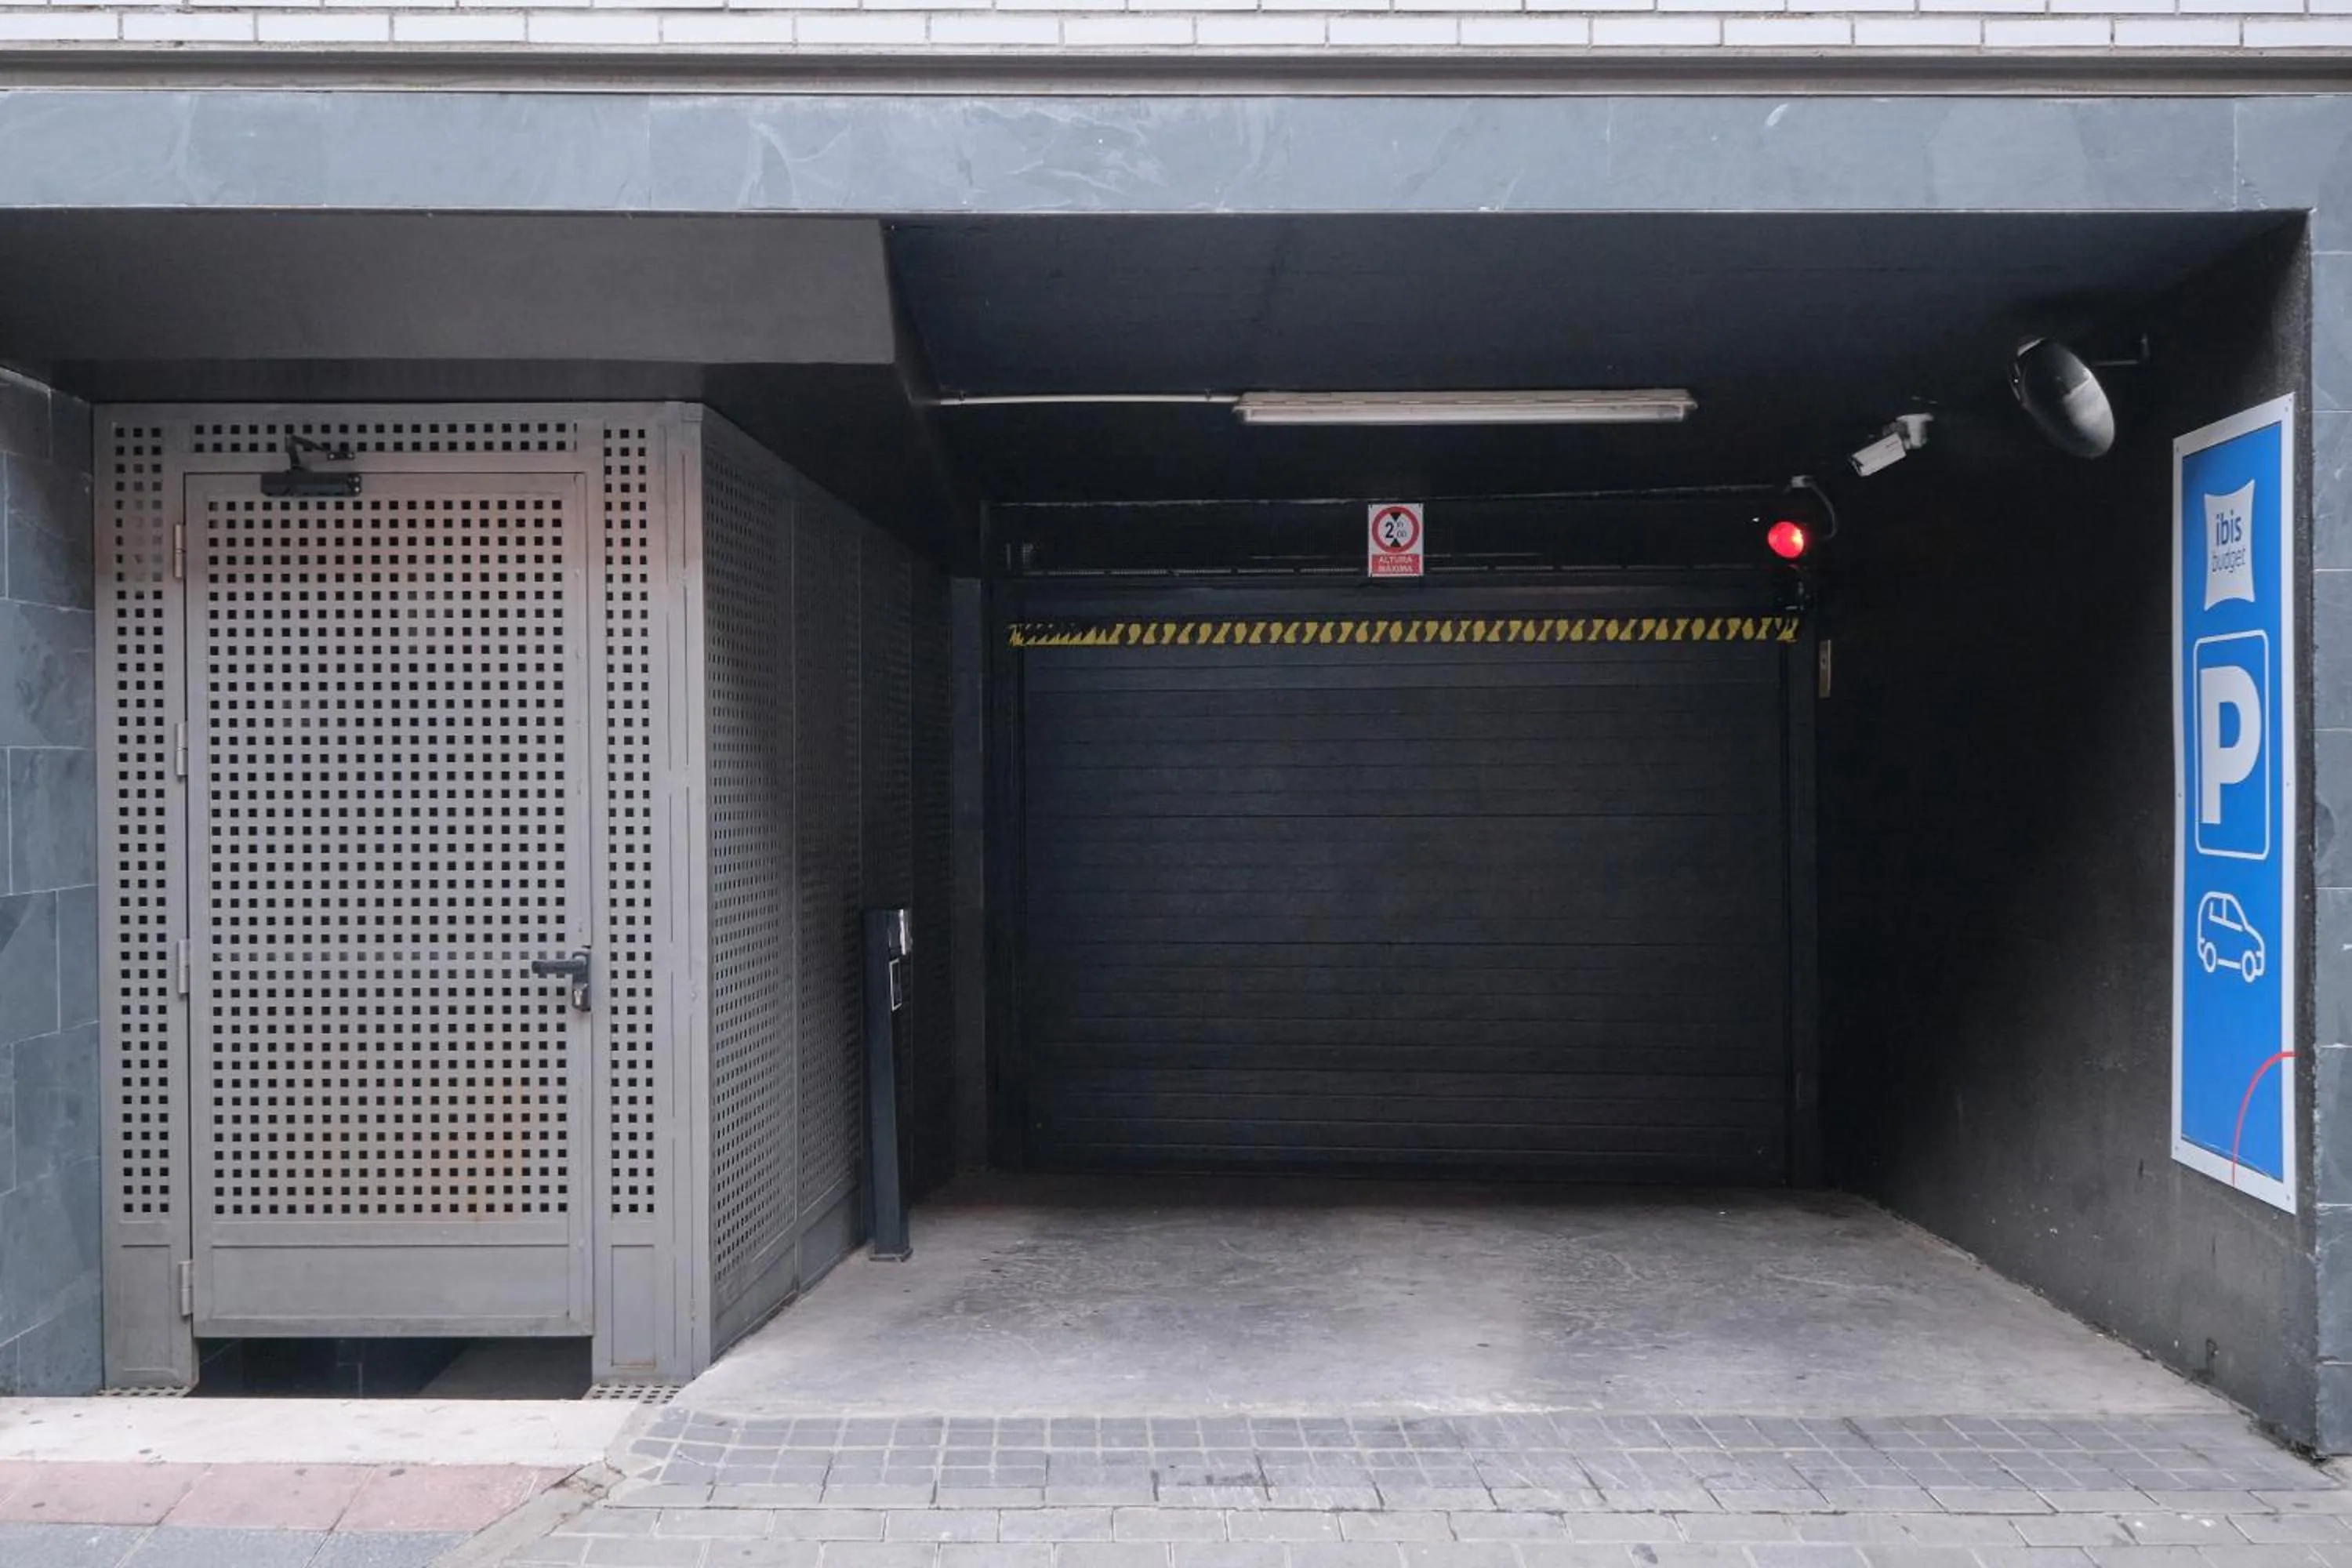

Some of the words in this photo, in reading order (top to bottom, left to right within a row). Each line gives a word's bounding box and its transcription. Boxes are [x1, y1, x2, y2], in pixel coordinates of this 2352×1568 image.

[2216, 510, 2242, 546] ibis
[2212, 547, 2246, 573] budget
[2200, 666, 2261, 824] P
